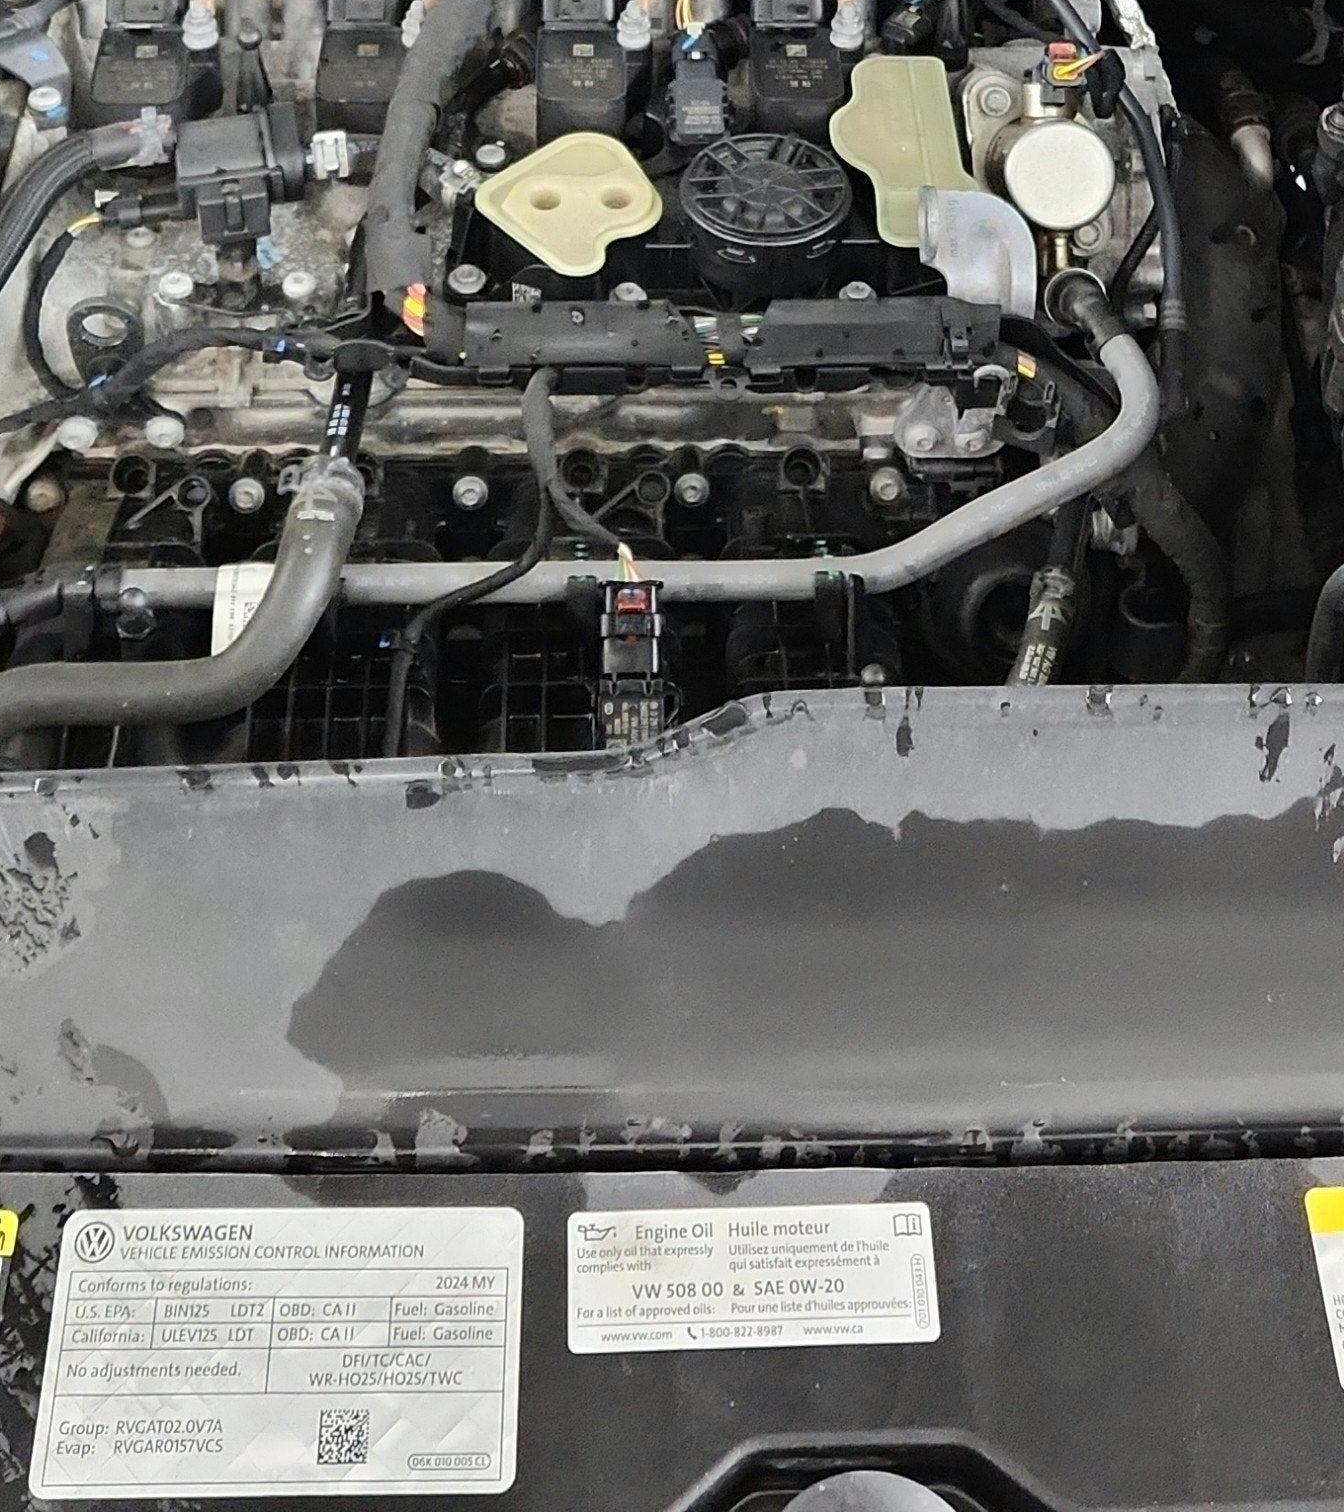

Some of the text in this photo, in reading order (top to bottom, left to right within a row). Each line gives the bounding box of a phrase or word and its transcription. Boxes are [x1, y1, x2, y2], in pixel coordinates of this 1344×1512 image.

[122, 1224, 253, 1242] VOLKSWAGEN
[635, 1222, 714, 1243] Engine Oil
[728, 1220, 831, 1238] Huile moteur
[119, 1244, 424, 1261] VEHICLE EMISSION CONTROL INFORMATION
[576, 1244, 714, 1262] Use only oil that expressly
[728, 1240, 890, 1258] Utilisez uniquement de l'huile
[576, 1259, 652, 1276] complies with
[728, 1253, 881, 1273] qui satisfait expressément à
[77, 1276, 253, 1296] Conforms to regulations:
[435, 1275, 496, 1290] 2024 MY
[631, 1277, 845, 1300] VW 508 00 & SAE 0W-20
[74, 1304, 136, 1320] U.S. EPA:
[163, 1302, 265, 1320] BIN125 LDT2
[279, 1302, 316, 1318] OBD:
[322, 1302, 343, 1317] CA
[394, 1301, 494, 1317] Fuel: Gasoline
[576, 1302, 716, 1320] For a list of approved oils:
[730, 1296, 912, 1314] Pour une liste d'huiles approuvées:
[71, 1328, 145, 1346] California:
[161, 1327, 255, 1343] ULEV125 LDT
[276, 1326, 314, 1342] OBD:
[320, 1326, 341, 1342] CA
[393, 1325, 493, 1341] Fuel: Gasoline
[600, 1330, 673, 1343] www.vw.com
[700, 1324, 784, 1339] 1-800-822-8987
[802, 1324, 864, 1336] www.vw.ca
[342, 1352, 432, 1369] DFI/TC/CAC/
[66, 1361, 241, 1382] No adjustments needed.
[58, 1418, 223, 1440] Group: RVGAT02.0V7A
[56, 1438, 224, 1459] Evap: RVGAR0157VCS
[412, 1456, 433, 1468] 06K
[434, 1456, 453, 1468] 010
[453, 1456, 473, 1467] 005
